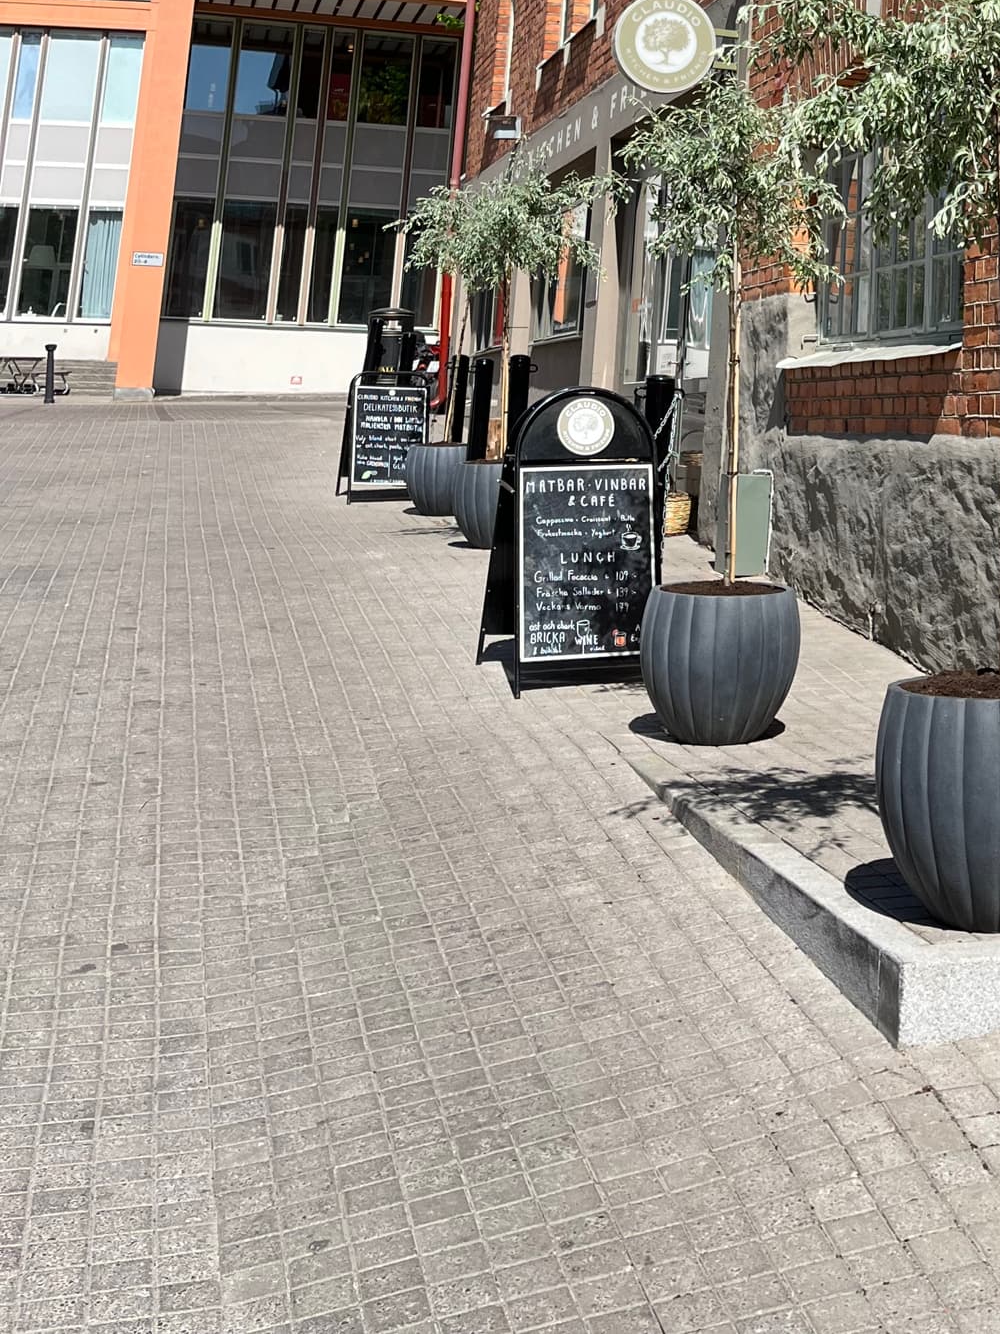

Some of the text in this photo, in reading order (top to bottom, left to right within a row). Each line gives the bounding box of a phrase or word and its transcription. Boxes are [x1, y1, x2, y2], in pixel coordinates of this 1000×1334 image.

[632, 0, 701, 27] CLAUDIO
[591, 106, 599, 130] &
[565, 401, 606, 418] CLAUDIO
[525, 478, 646, 494] MATBAR VINBAR
[568, 493, 615, 507] & CAFÉ
[560, 551, 615, 564] LUNCH
[530, 632, 599, 645] BRICKA WINE
